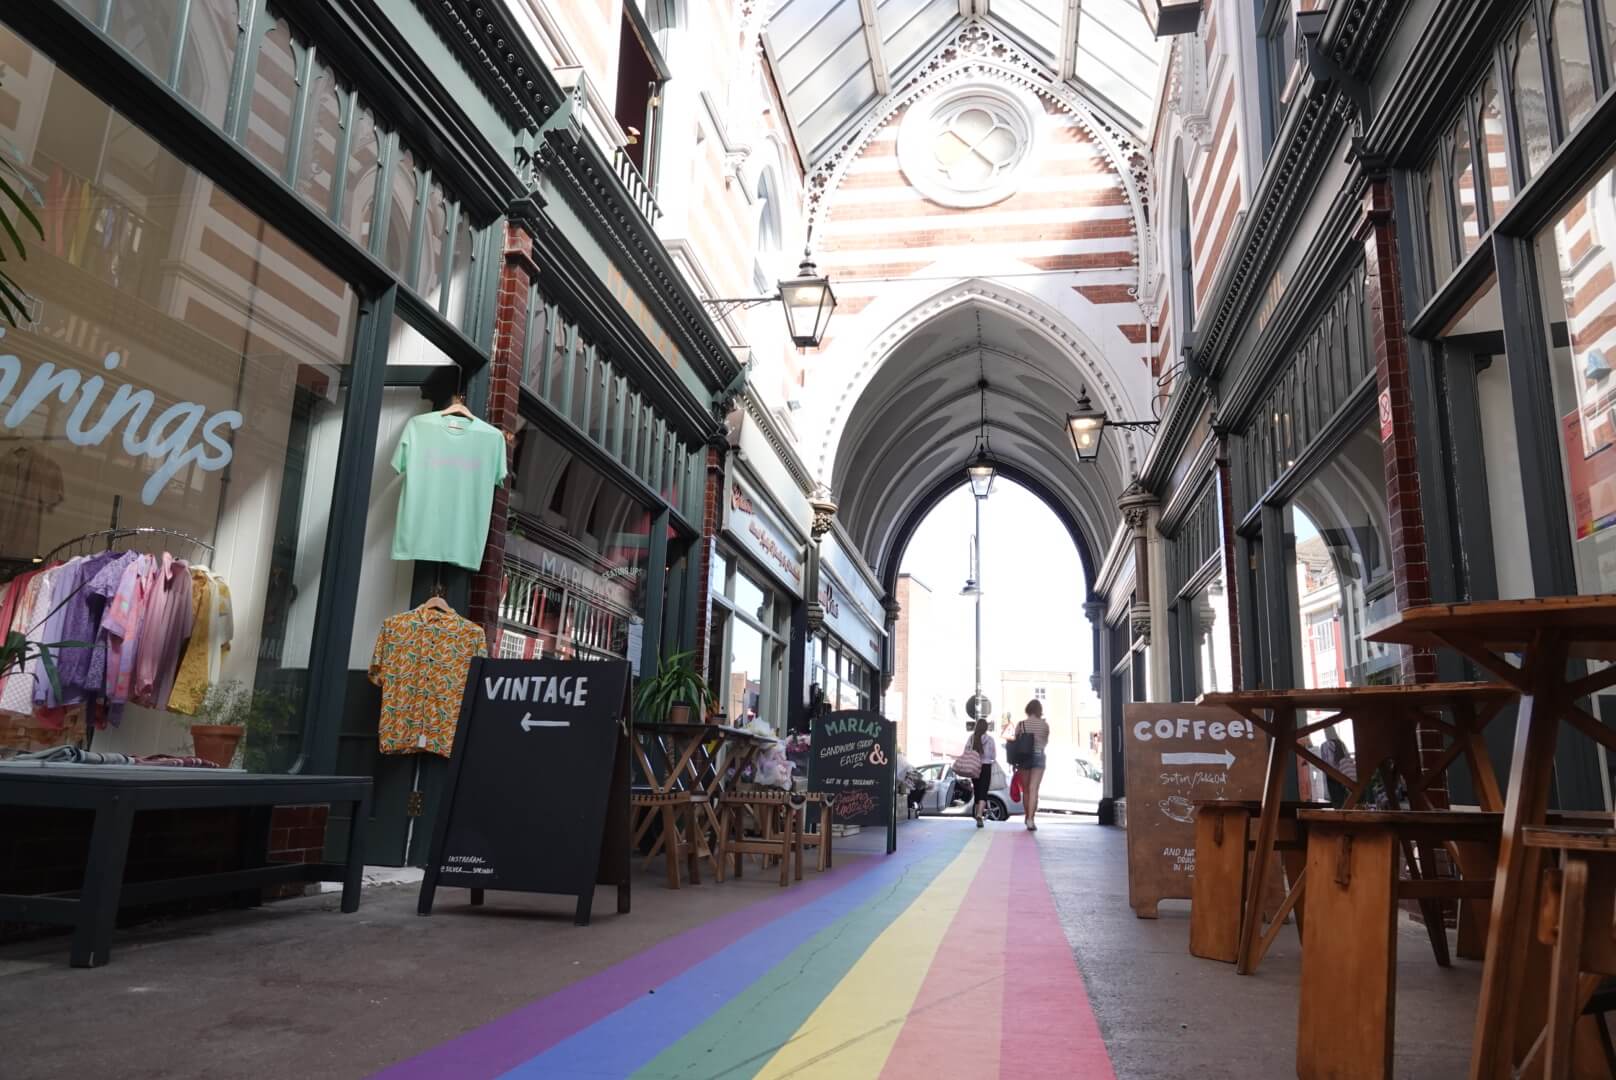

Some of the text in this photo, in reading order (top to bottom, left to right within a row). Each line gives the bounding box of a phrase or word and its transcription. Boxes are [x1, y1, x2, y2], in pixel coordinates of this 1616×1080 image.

[485, 676, 588, 707] VINTAGE
[825, 717, 883, 739] MARLA'S
[869, 743, 888, 766] &
